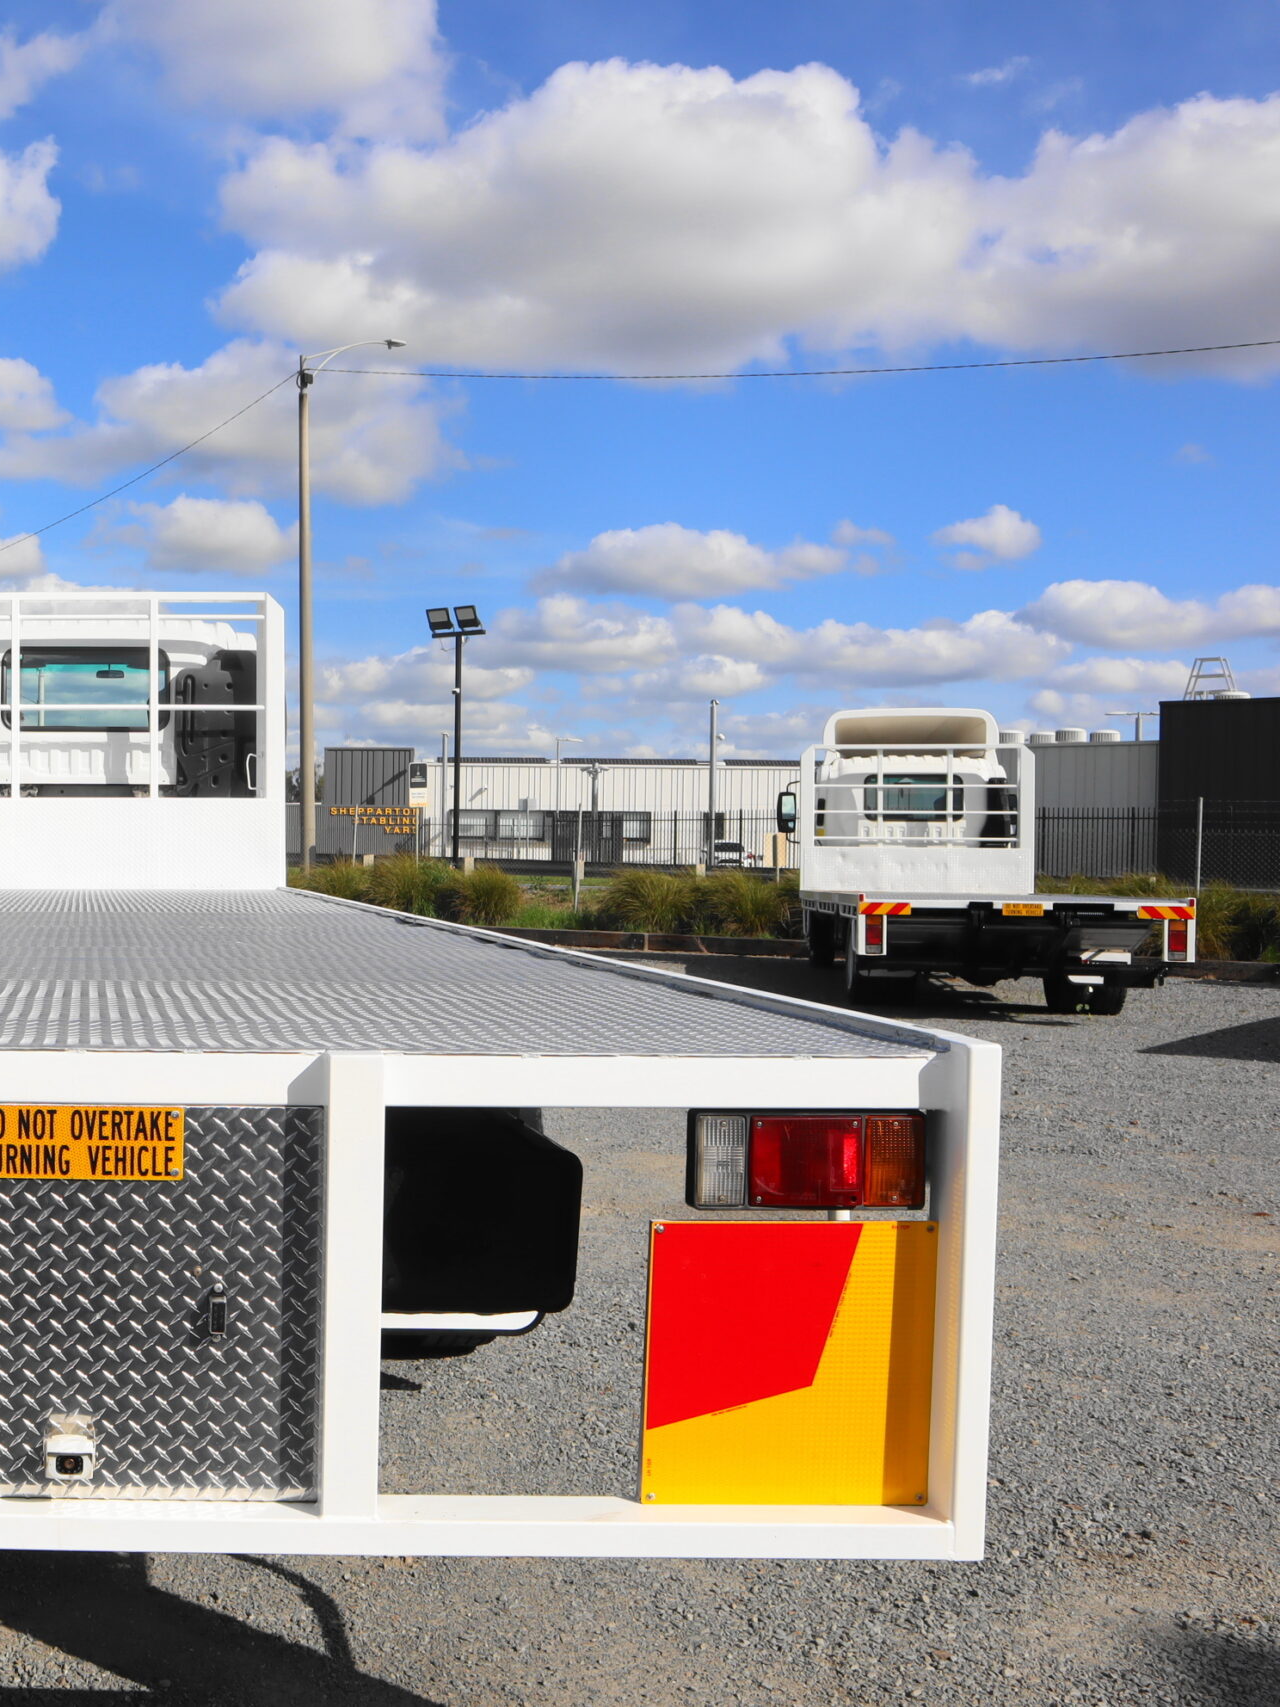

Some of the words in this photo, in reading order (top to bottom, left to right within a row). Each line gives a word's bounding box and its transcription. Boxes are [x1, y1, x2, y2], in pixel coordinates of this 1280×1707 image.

[18, 1109, 57, 1140] NOT
[70, 1109, 176, 1142] OVERTAKE
[87, 1146, 176, 1177] VEHICLE
